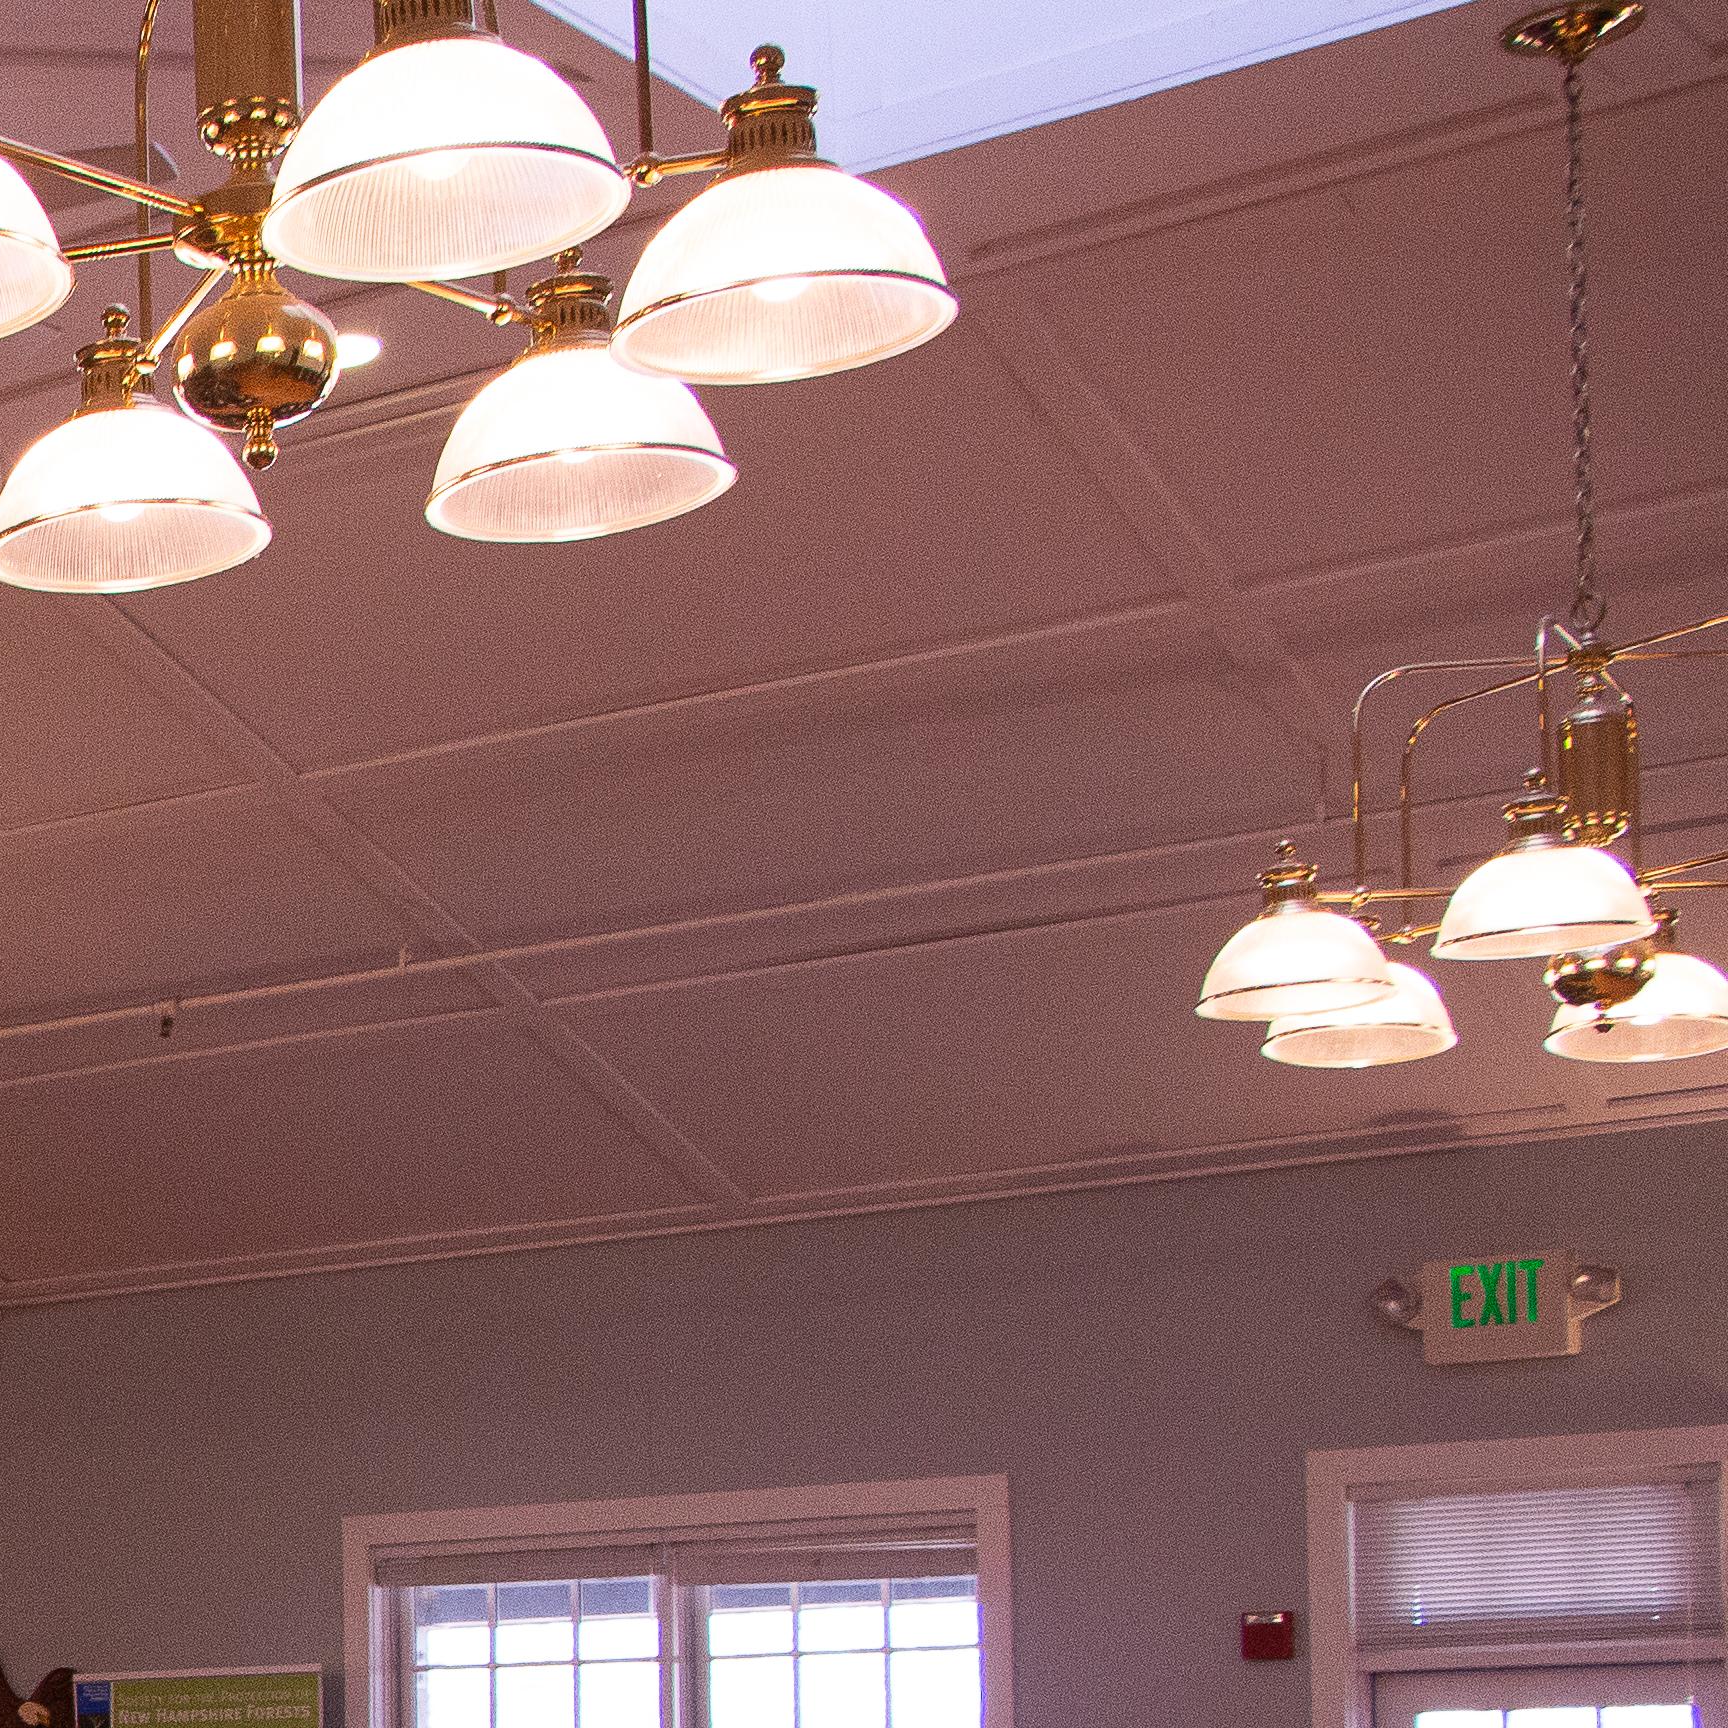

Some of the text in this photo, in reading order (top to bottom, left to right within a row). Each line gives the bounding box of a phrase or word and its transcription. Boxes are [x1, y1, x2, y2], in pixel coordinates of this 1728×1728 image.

[1449, 1259, 1545, 1329] EXIT
[119, 1704, 311, 1724] NEW HAMPSHIRE FORESTS
